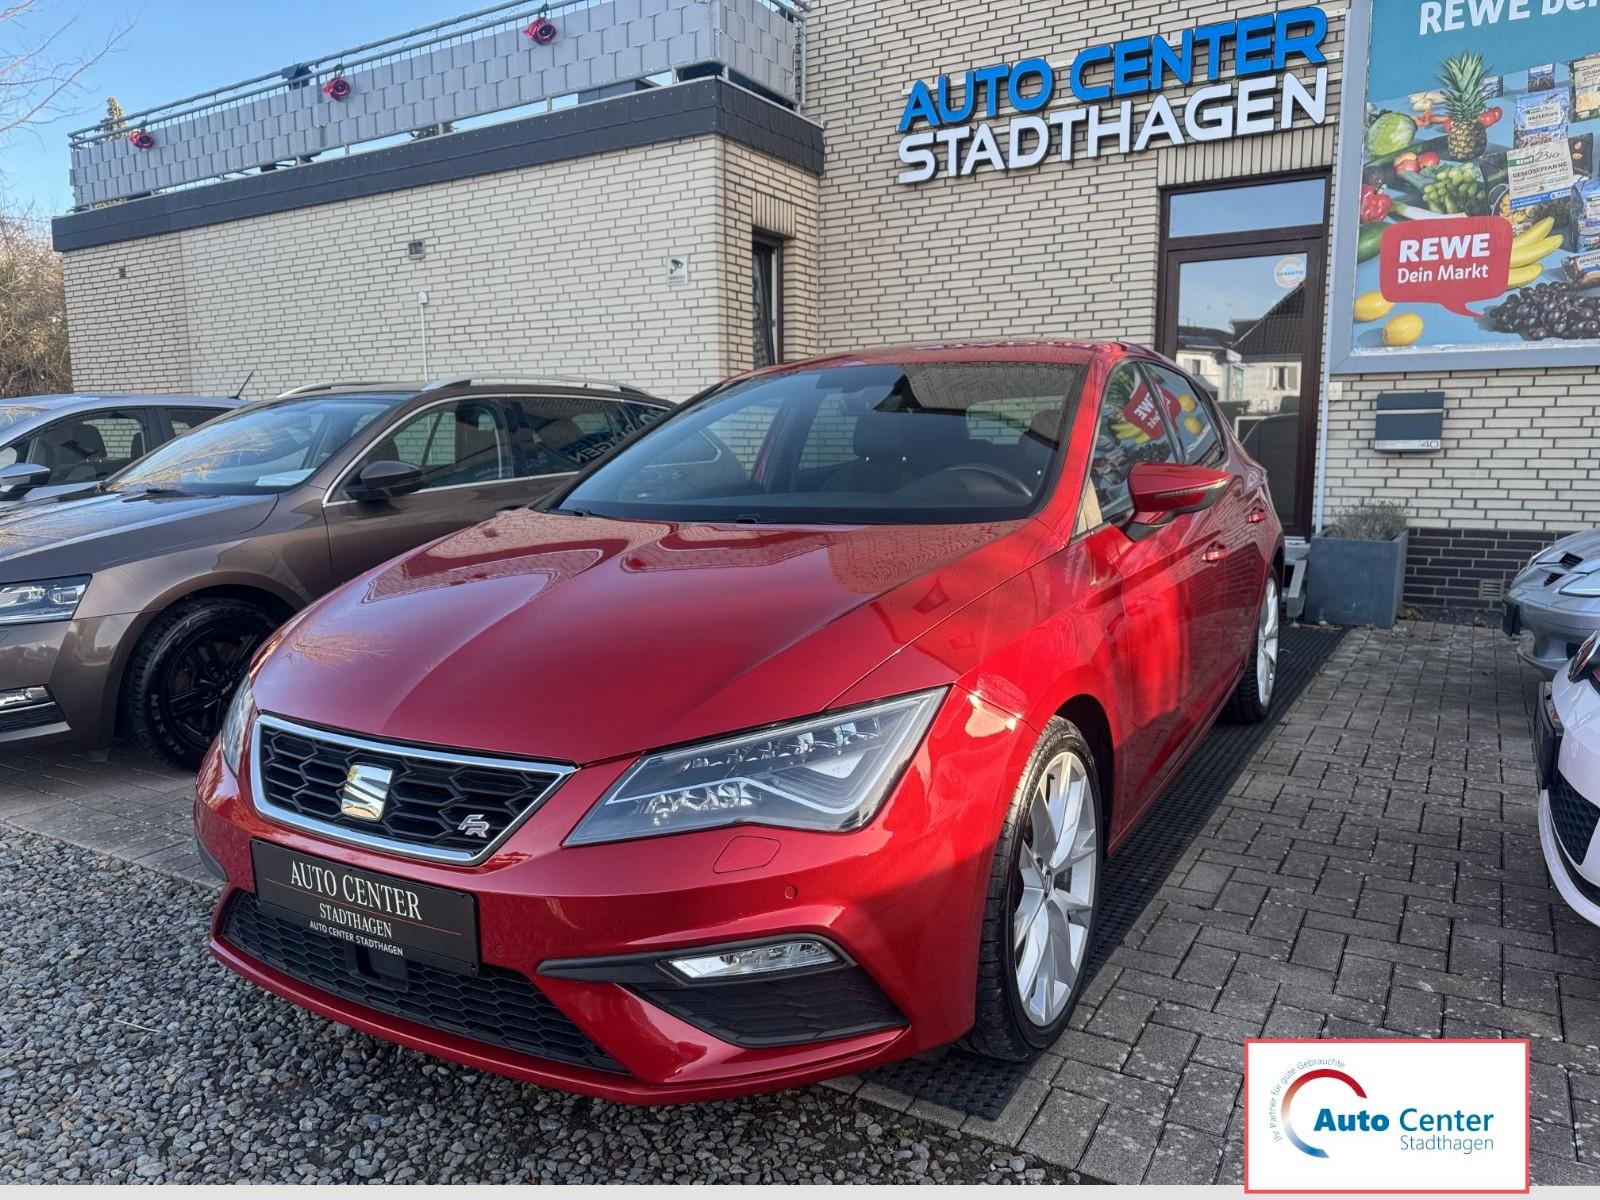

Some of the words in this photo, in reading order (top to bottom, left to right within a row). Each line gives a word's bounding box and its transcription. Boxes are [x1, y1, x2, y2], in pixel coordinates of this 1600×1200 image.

[1419, 0, 1531, 35] REWE
[899, 57, 1053, 132] AUTO
[1070, 6, 1328, 102] CENTER
[898, 67, 1328, 184] STADTHAGEN
[1399, 233, 1491, 263] REWE
[1397, 267, 1433, 284] Dein
[1437, 264, 1489, 281] Markt
[457, 814, 490, 838] FR
[291, 859, 337, 897] AUTO
[343, 874, 423, 921] CENTER
[309, 920, 328, 933] AUTO
[328, 926, 354, 942] CENTER
[356, 935, 404, 956] STADTHAGEN
[319, 902, 392, 939] STADTHAGEN
